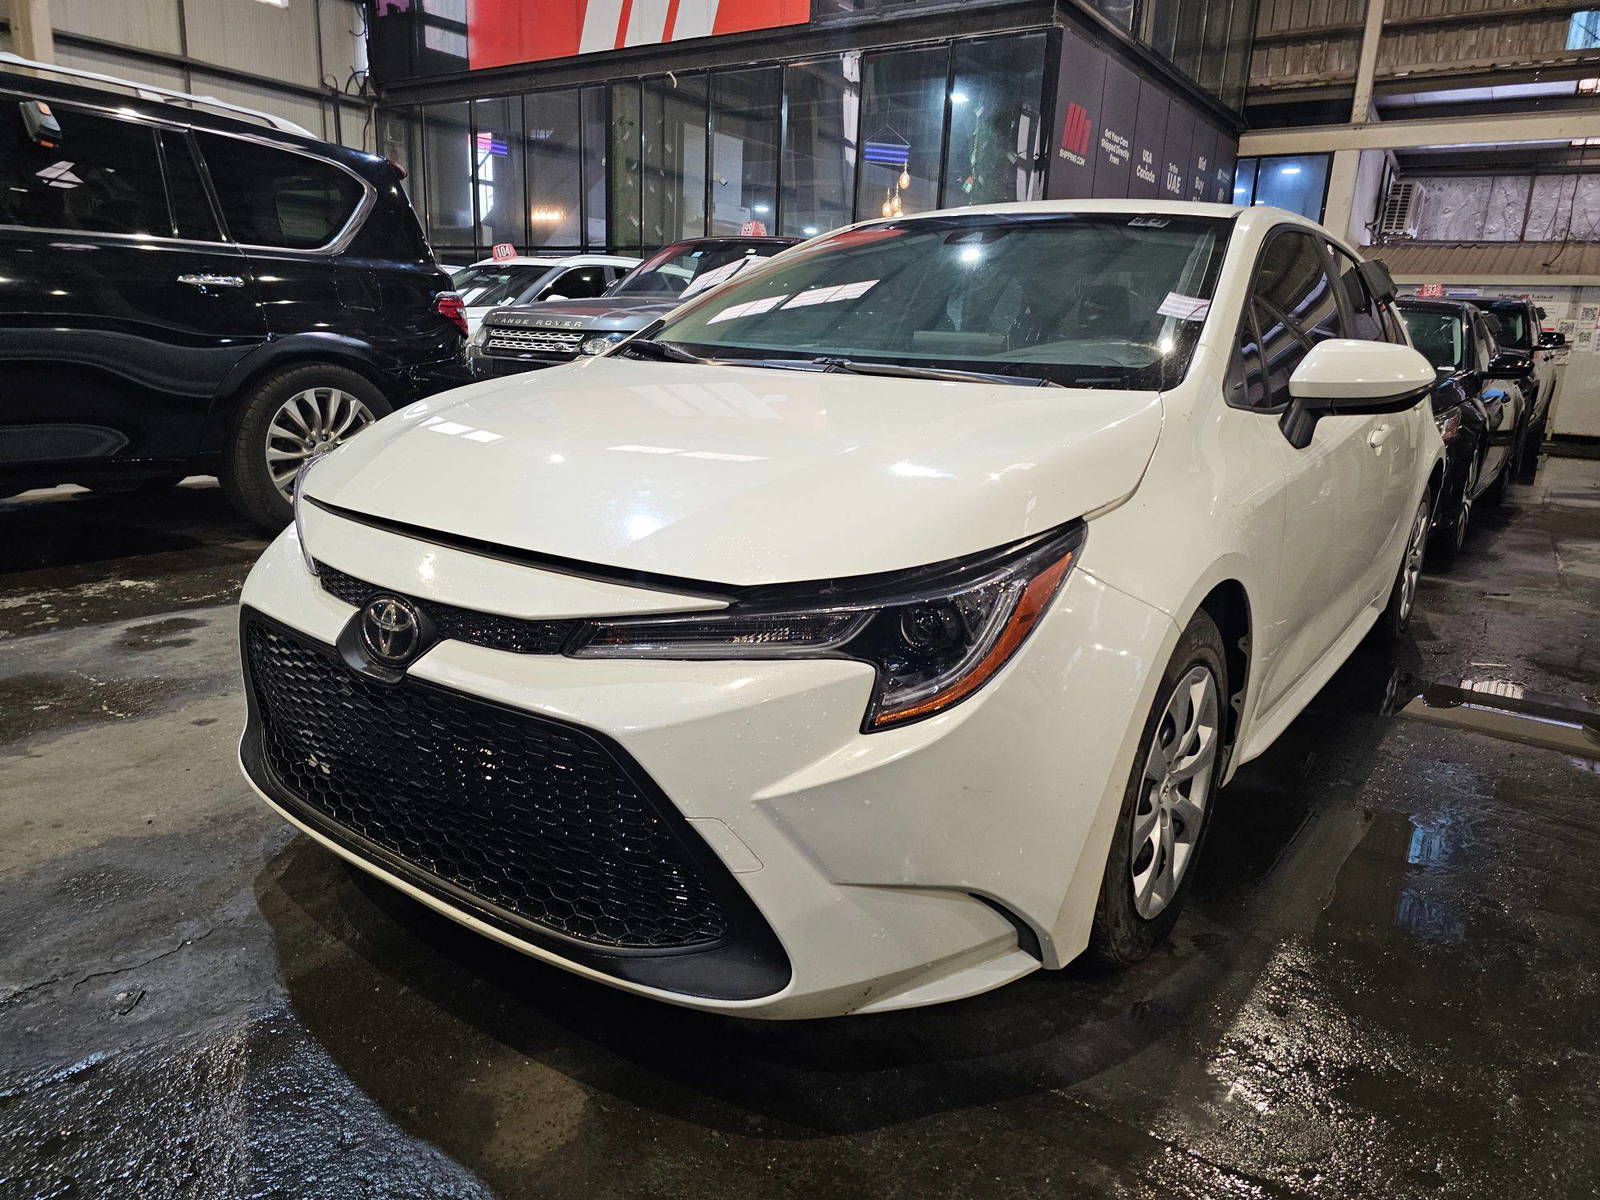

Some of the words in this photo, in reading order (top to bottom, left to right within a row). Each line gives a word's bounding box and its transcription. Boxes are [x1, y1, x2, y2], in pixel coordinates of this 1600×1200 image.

[1142, 149, 1153, 165] USA
[1136, 164, 1156, 184] Canada
[1166, 172, 1181, 195] UAE
[496, 245, 511, 258] 104
[535, 319, 583, 328] ROVER
